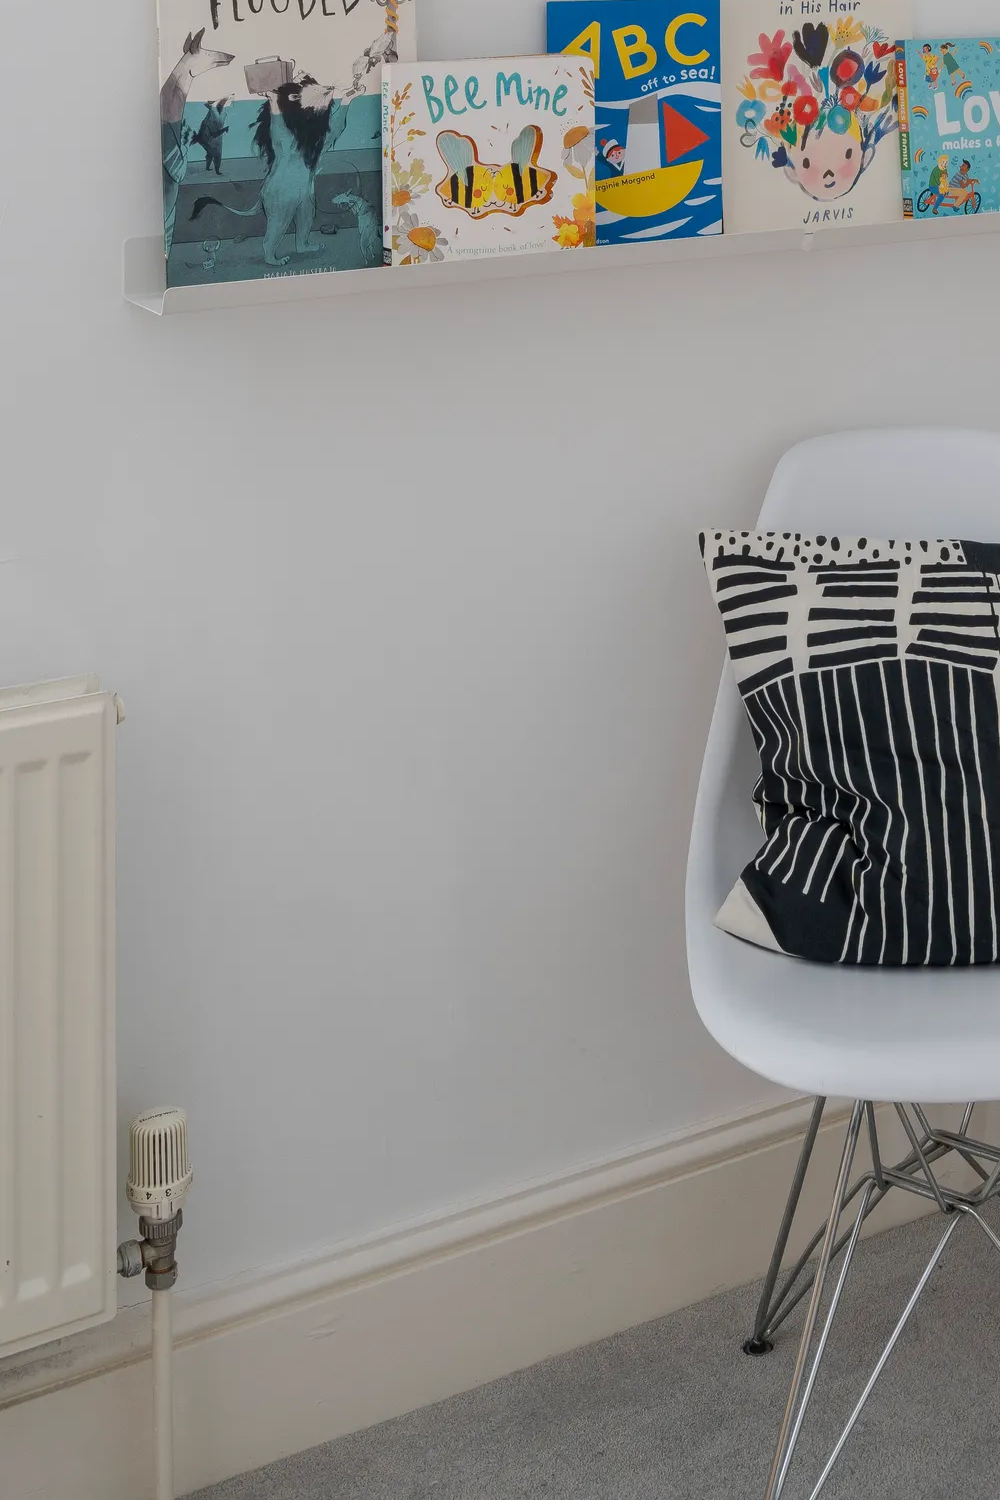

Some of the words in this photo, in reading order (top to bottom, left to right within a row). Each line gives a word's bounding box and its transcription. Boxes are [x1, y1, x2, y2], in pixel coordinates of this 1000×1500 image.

[780, 1, 792, 15] in
[801, 0, 822, 14] His
[560, 13, 711, 80] ABC
[640, 79, 658, 92] off
[663, 74, 676, 84] to
[681, 65, 716, 80] sea!
[421, 74, 488, 124] Bee
[496, 72, 568, 116] Mine
[942, 137, 981, 150] makes
[984, 139, 993, 148] a
[595, 181, 619, 192] irginie
[621, 173, 655, 184] Morgand
[803, 207, 854, 224] JARVIS
[447, 246, 453, 254] A
[455, 246, 496, 256] springtime
[498, 245, 517, 253] book
[519, 241, 529, 250] of
[529, 240, 547, 249] love!
